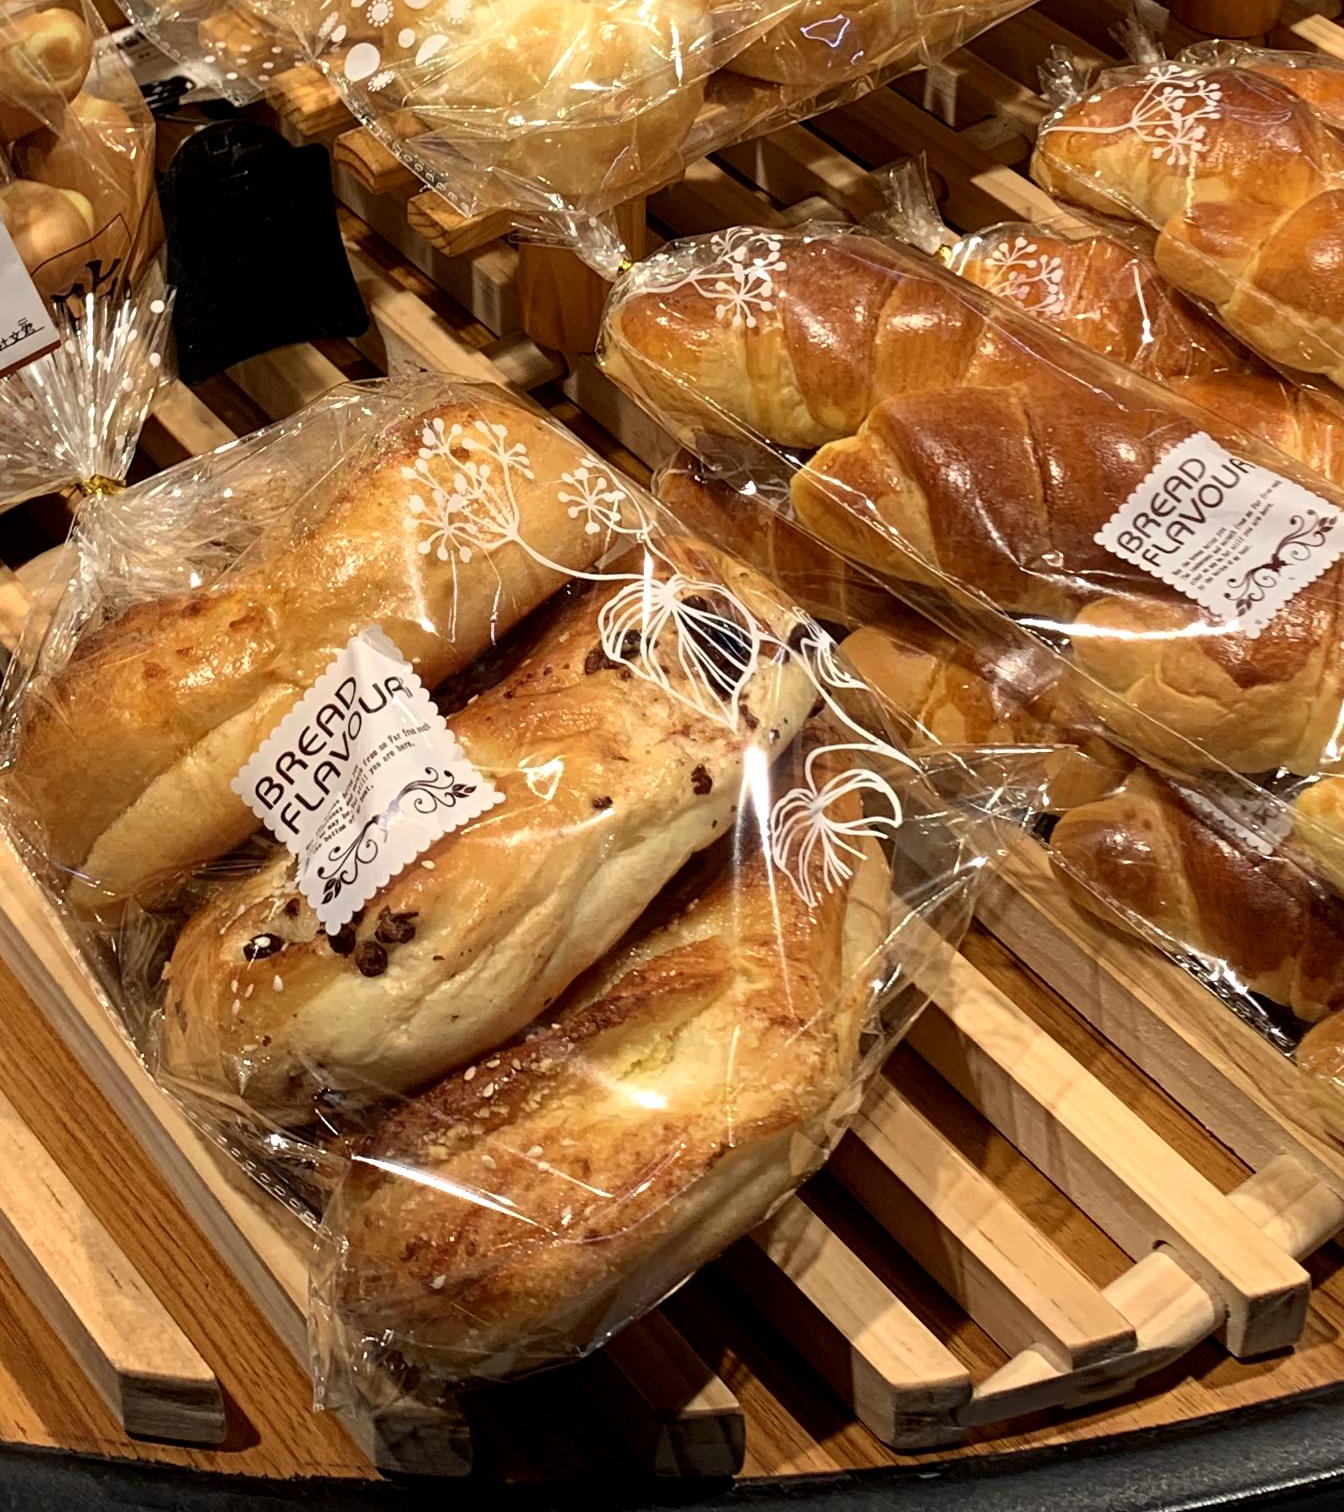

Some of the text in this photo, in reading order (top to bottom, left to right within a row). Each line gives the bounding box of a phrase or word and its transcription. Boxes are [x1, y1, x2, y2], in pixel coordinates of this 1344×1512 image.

[1116, 457, 1207, 554] BREAD
[1142, 457, 1256, 568] FLAVOUR
[255, 676, 357, 811] BREAD
[280, 676, 414, 836] FLAVOUR
